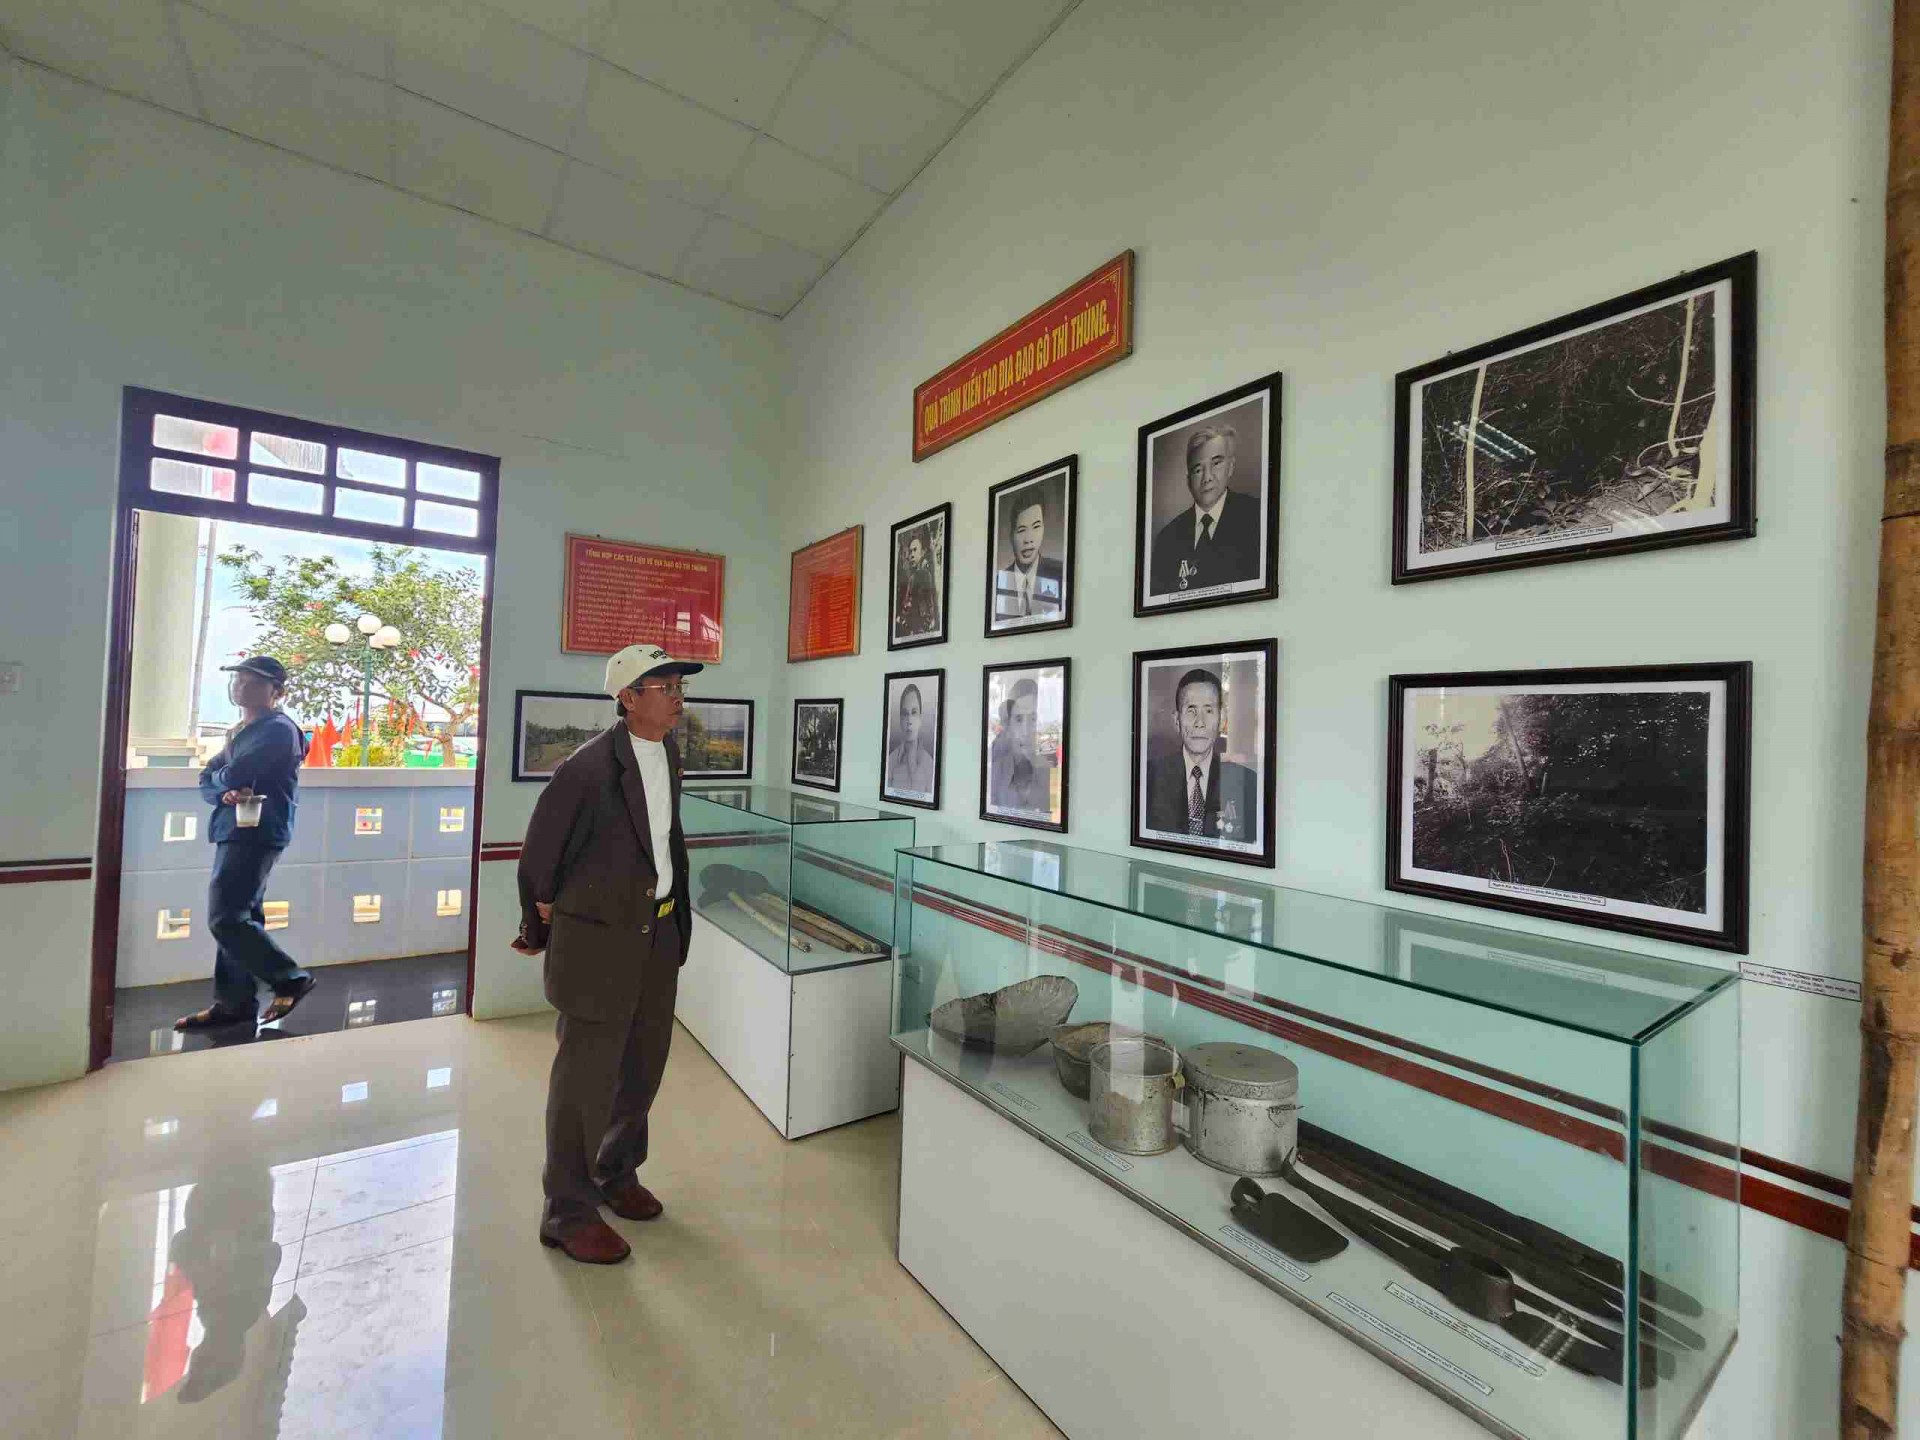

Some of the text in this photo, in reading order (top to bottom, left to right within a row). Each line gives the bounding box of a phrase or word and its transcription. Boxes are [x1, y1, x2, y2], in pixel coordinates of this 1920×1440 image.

[924, 395, 938, 435] QUÁ
[939, 387, 961, 425] TRÌNH
[962, 367, 981, 412] KIẾN
[982, 363, 998, 405] TẠO
[999, 354, 1014, 396] ĐỊA
[1015, 342, 1035, 386] ĐẠO
[1036, 326, 1050, 371] GÒ
